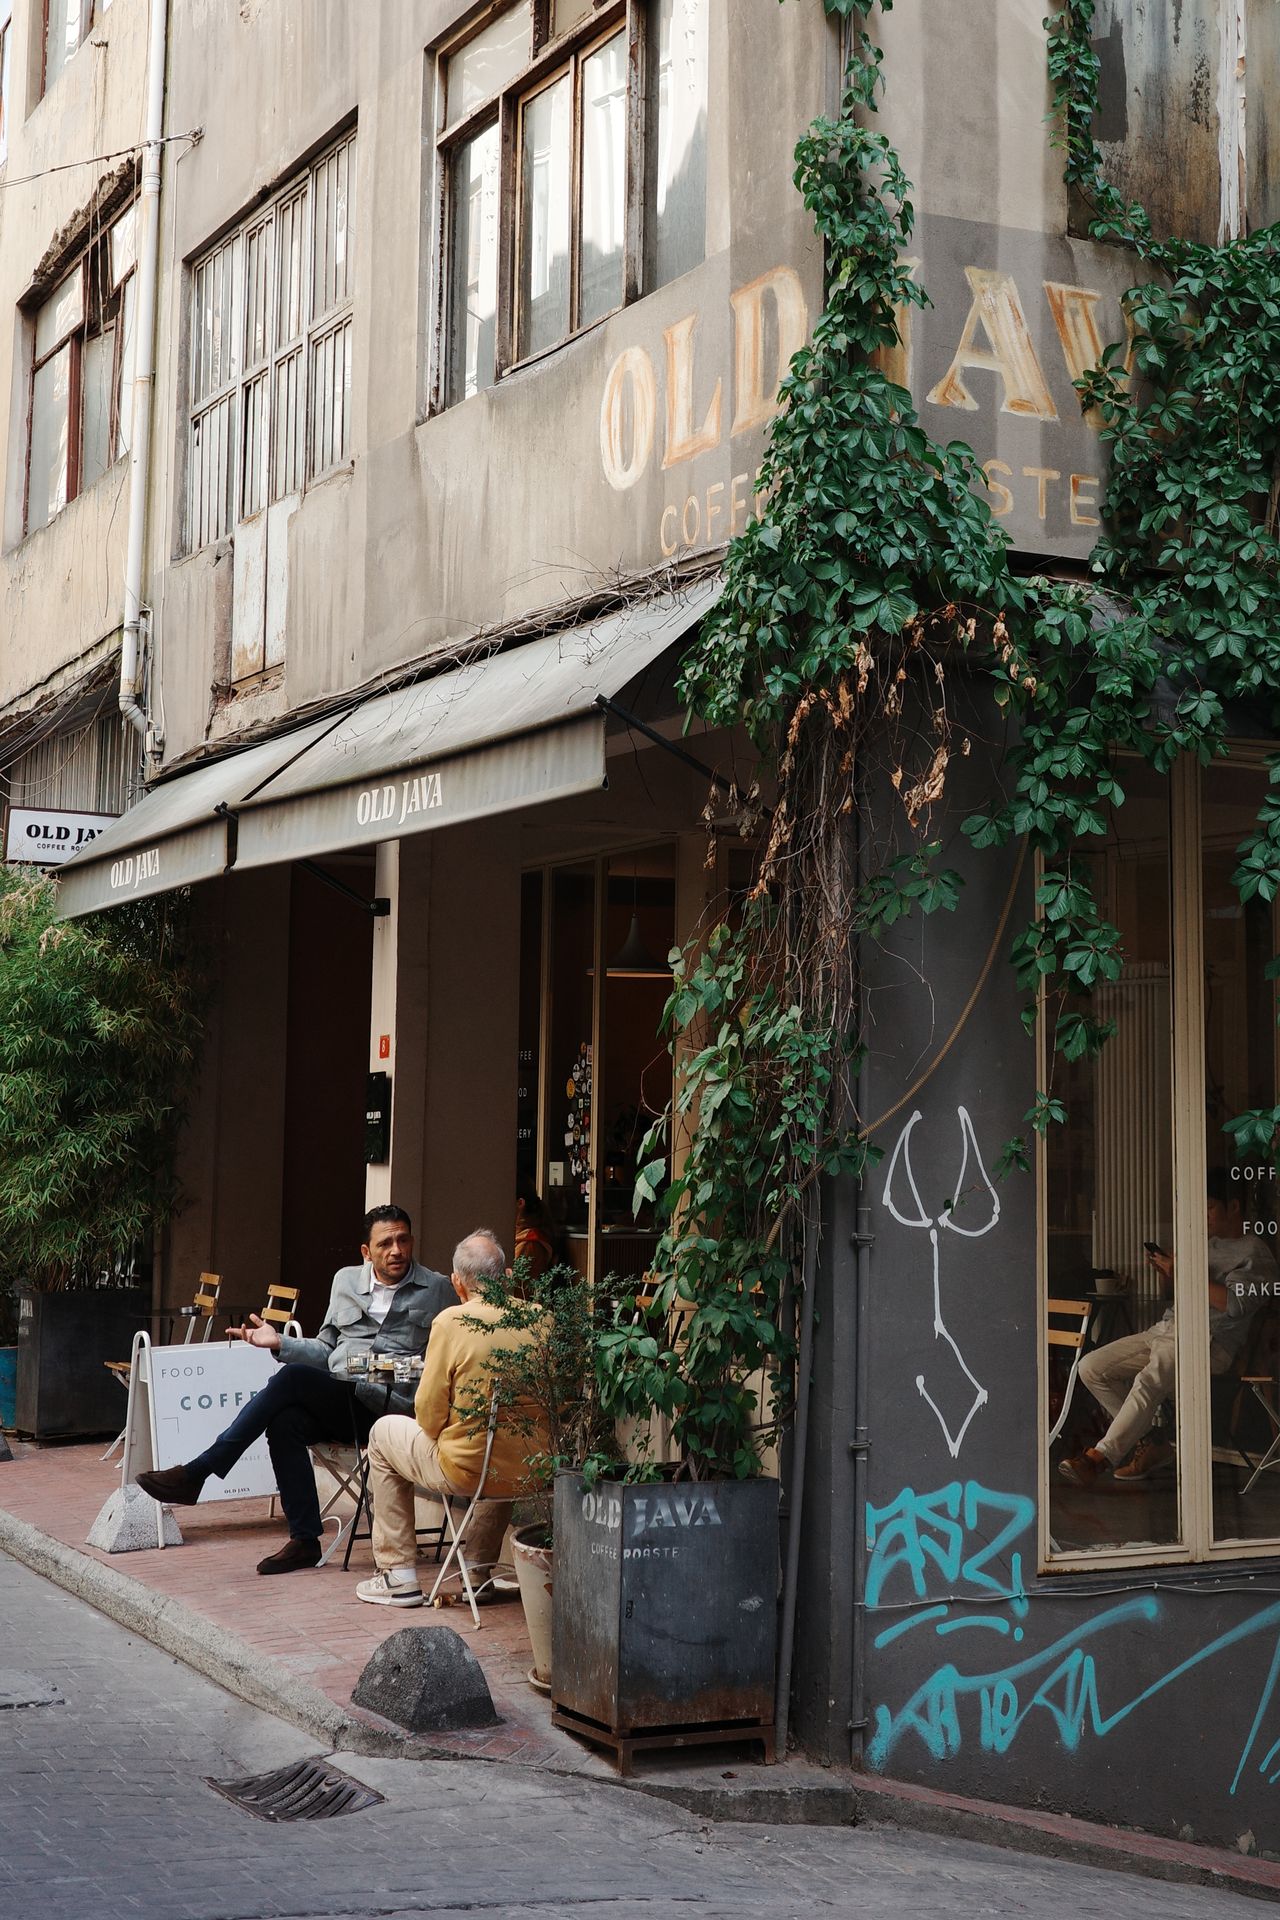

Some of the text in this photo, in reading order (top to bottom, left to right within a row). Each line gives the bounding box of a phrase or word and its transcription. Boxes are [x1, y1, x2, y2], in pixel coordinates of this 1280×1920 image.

[600, 266, 808, 491] OLD
[356, 774, 442, 826] OLD JAVA
[26, 824, 70, 840] OLD
[37, 842, 66, 851] COFFEE
[110, 848, 160, 889] OLD JAVA
[161, 1366, 205, 1378] FOOD
[582, 1493, 722, 1537] OLD JAVA
[591, 1542, 618, 1560] COFFEE
